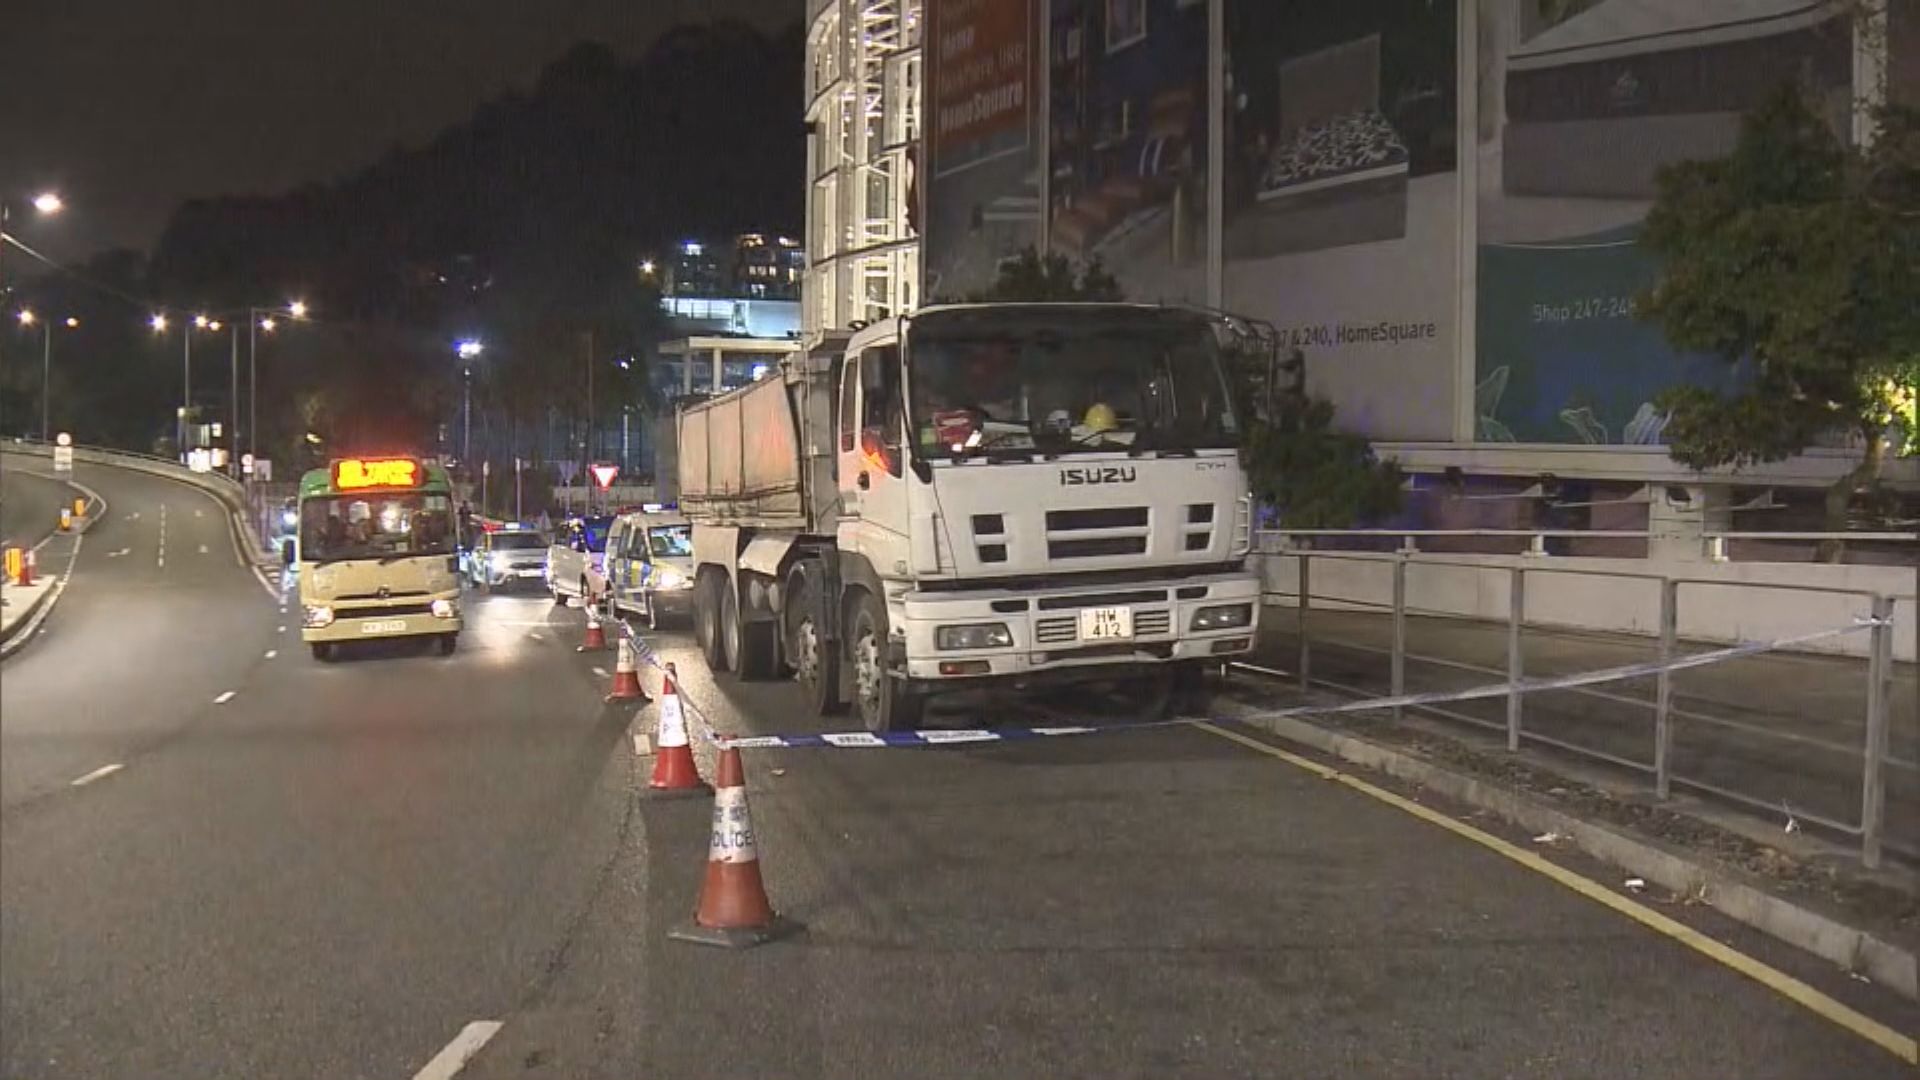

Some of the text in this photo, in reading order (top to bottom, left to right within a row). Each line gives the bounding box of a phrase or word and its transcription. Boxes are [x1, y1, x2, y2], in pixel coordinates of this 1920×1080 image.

[1533, 303, 1569, 324] Shop
[1337, 321, 1436, 345] HomeSquare
[1060, 466, 1137, 486] ISUZU
[1095, 608, 1116, 623] HW
[1092, 622, 1121, 637] 412
[711, 829, 753, 848] OLICE
